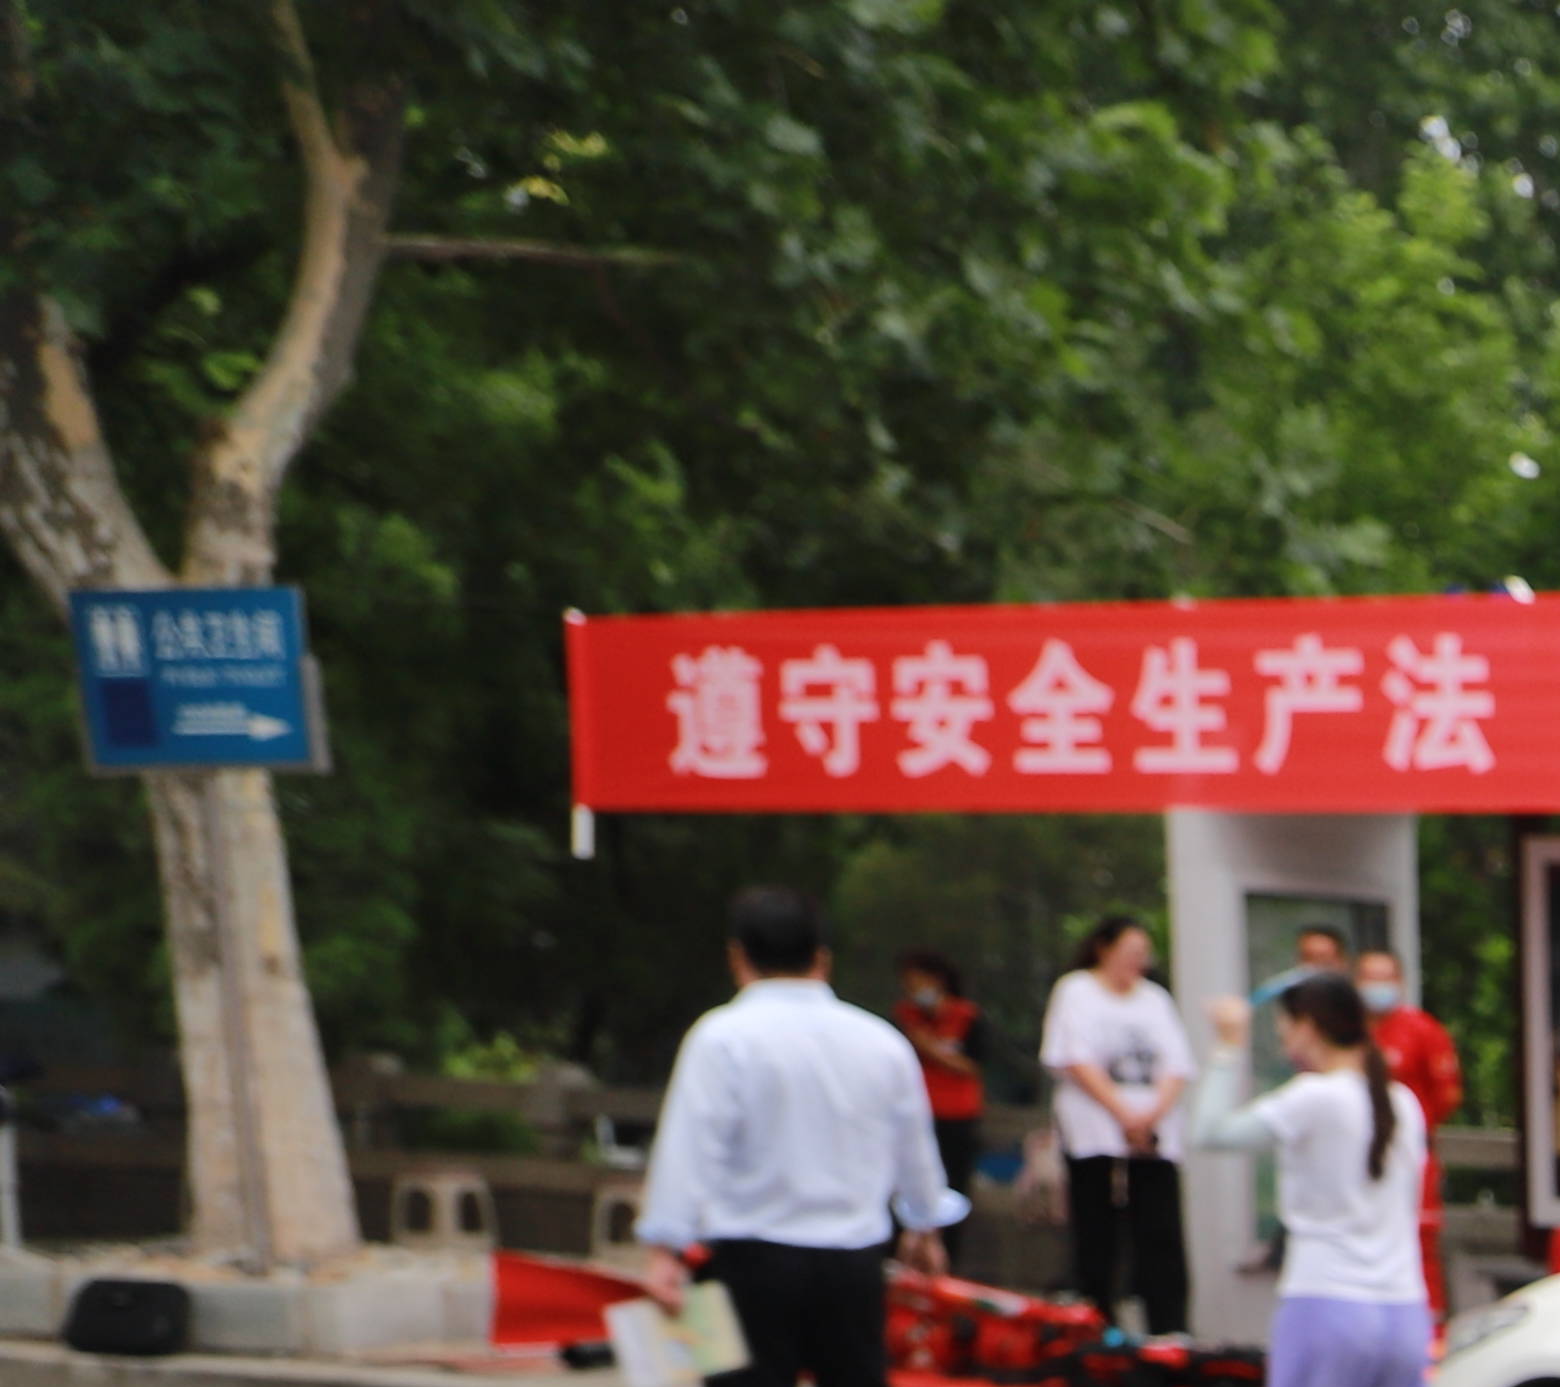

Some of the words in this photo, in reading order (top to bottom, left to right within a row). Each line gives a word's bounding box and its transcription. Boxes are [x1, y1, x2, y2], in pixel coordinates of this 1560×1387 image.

[668, 633, 1496, 780] 遵守安全生产法
